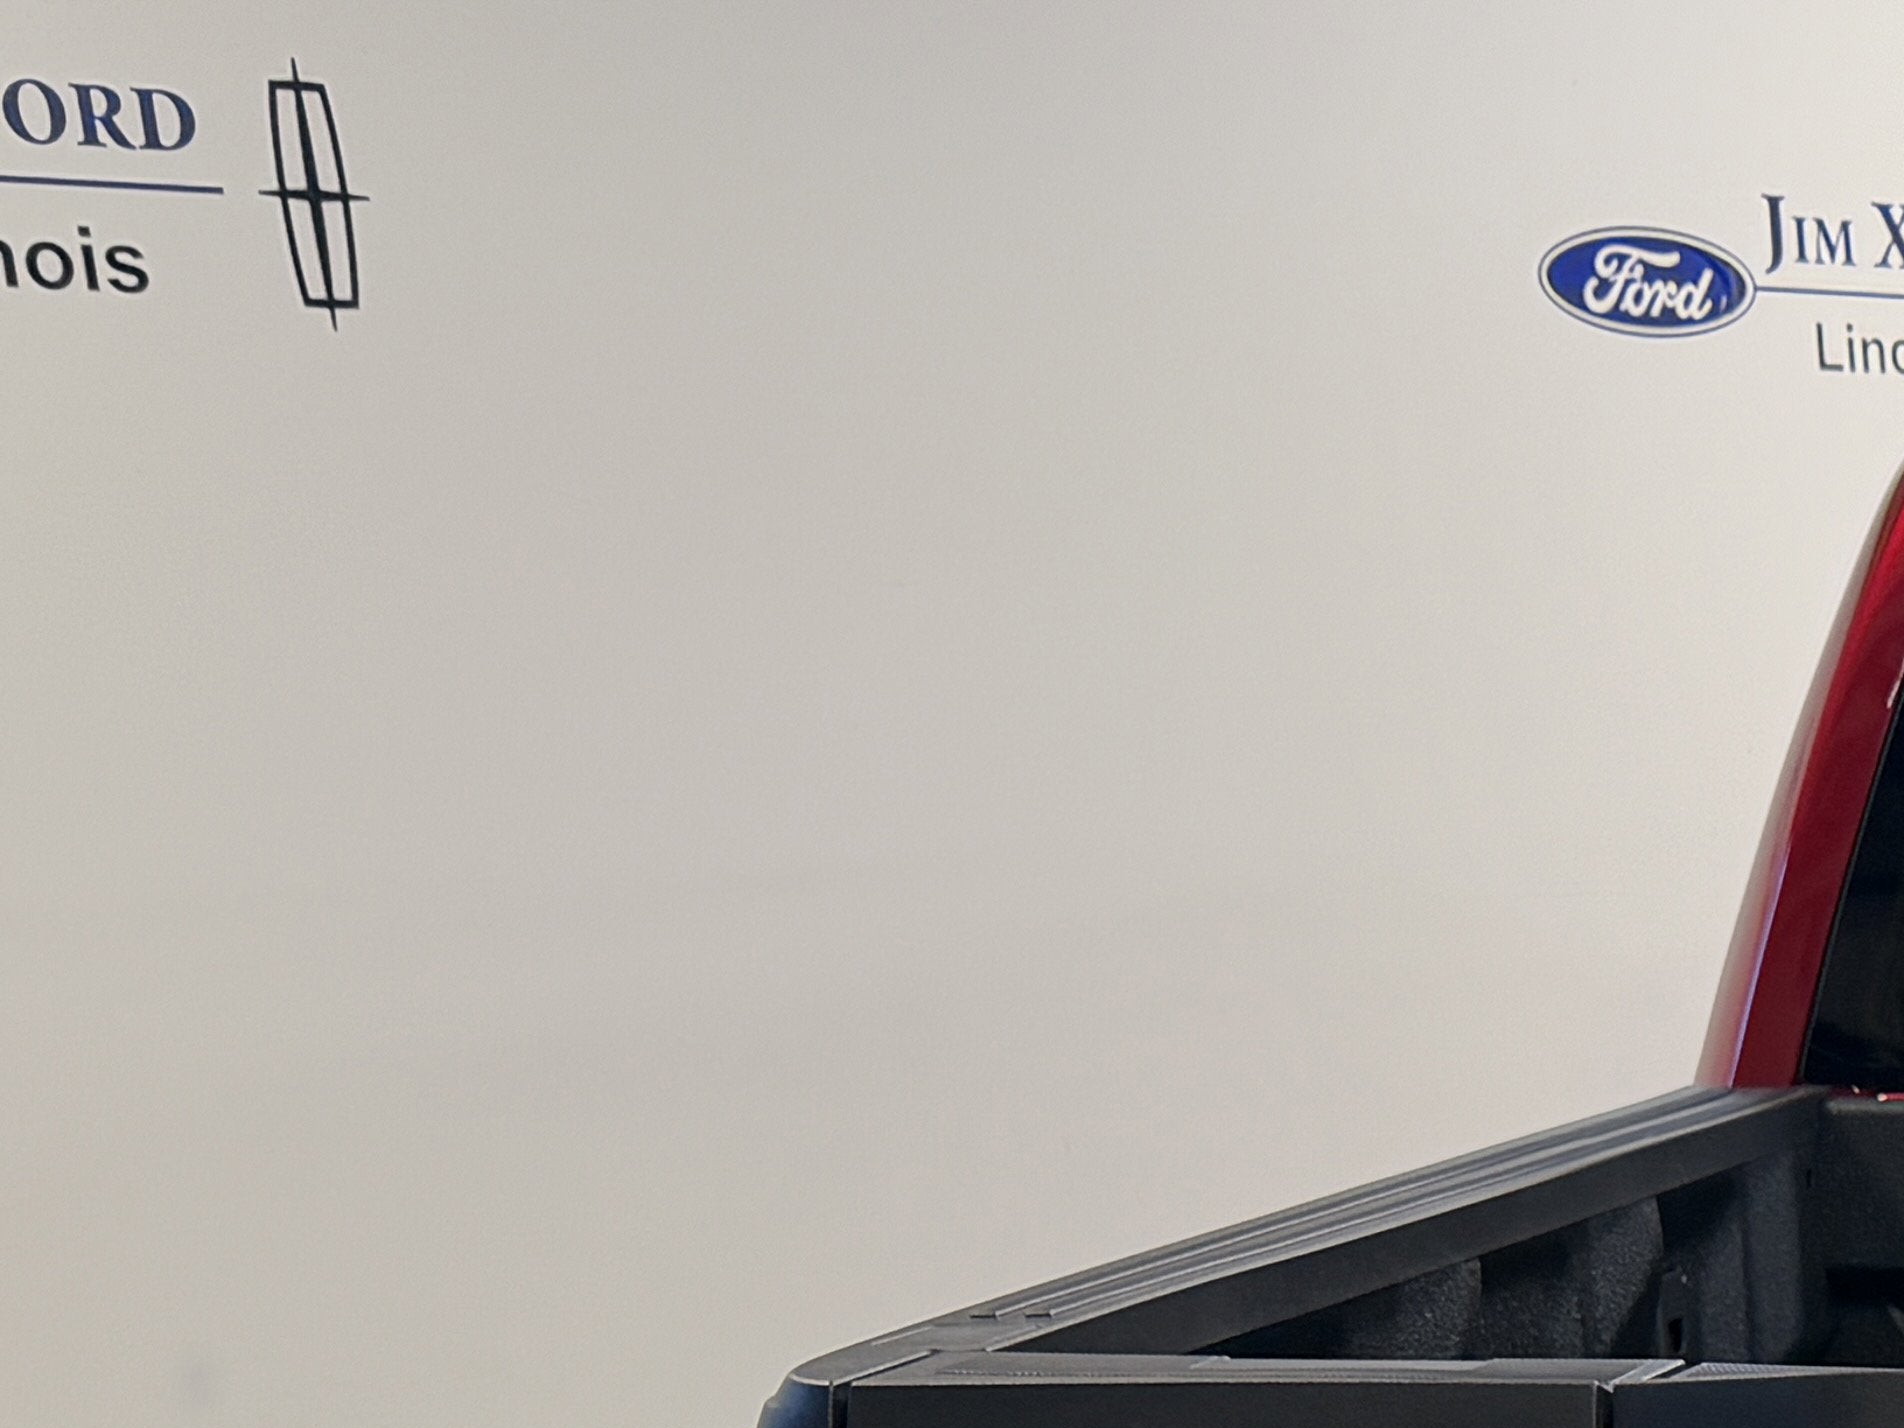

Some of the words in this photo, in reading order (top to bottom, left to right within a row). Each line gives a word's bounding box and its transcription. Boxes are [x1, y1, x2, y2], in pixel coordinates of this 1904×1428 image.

[1, 78, 196, 151] ORD
[1761, 194, 1855, 274] JIM
[1583, 245, 1714, 321] Ford
